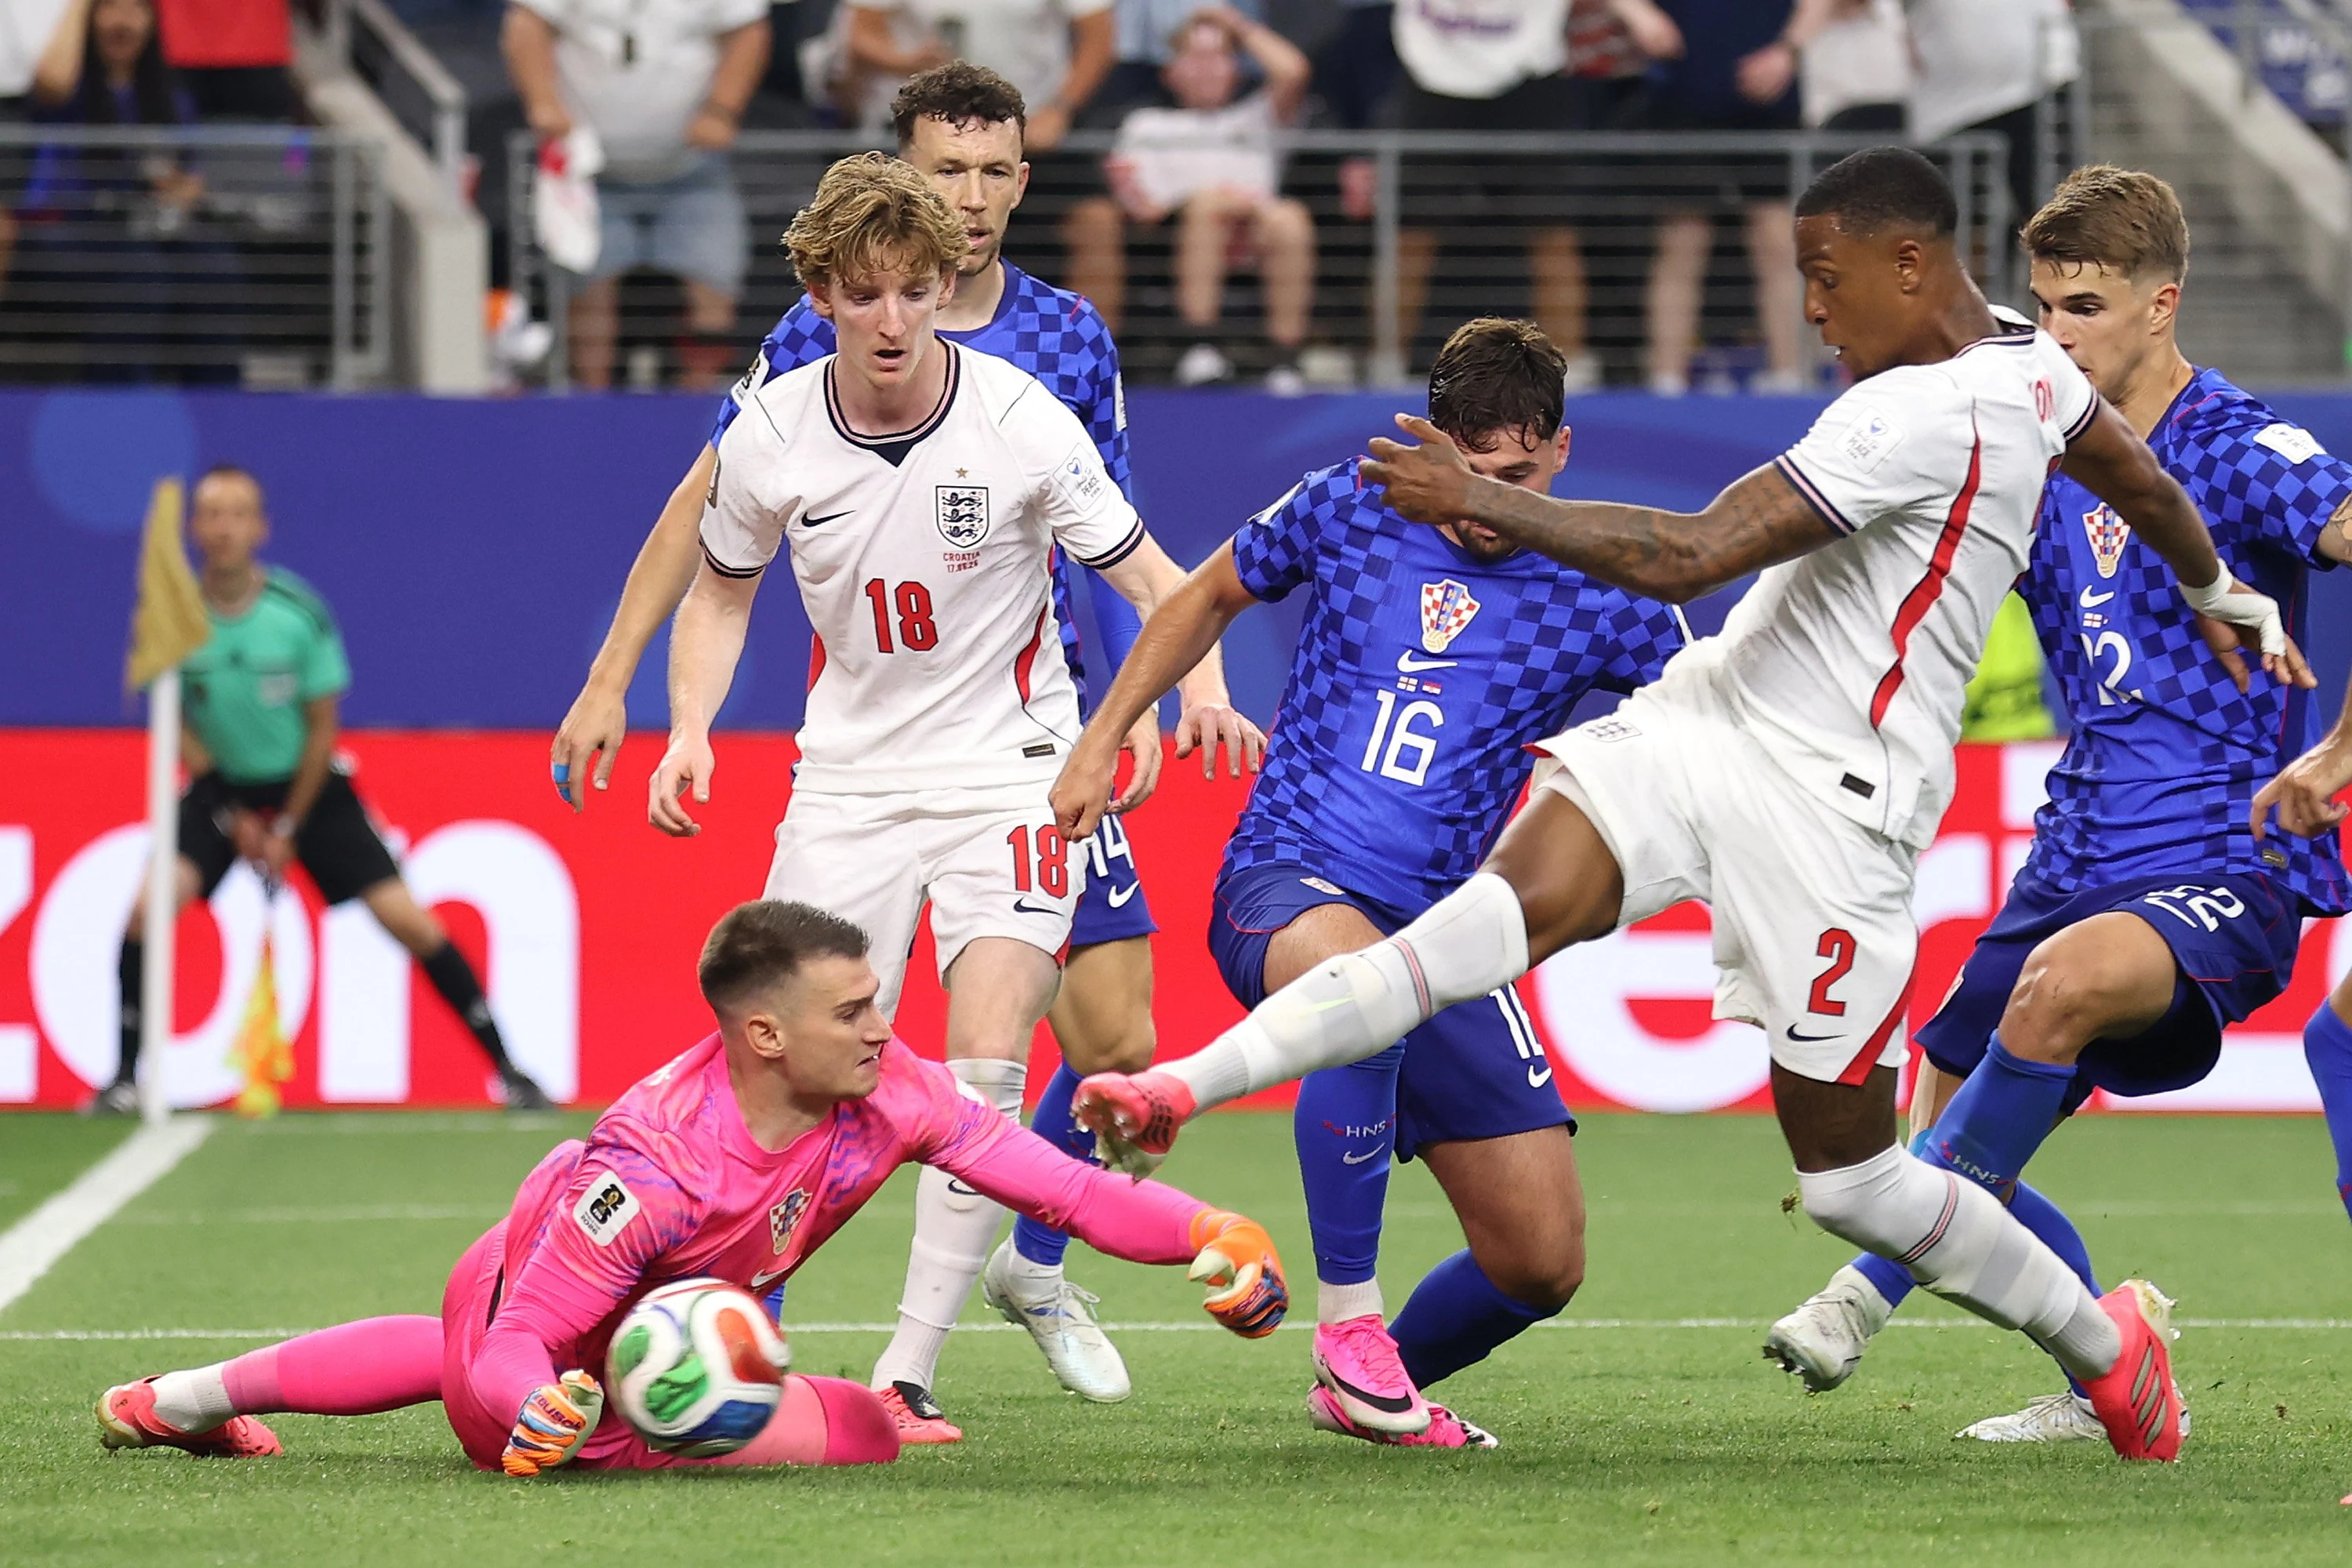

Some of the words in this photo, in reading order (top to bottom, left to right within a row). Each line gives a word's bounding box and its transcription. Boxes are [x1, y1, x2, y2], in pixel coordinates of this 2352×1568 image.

[942, 550, 981, 561] CROATIA
[865, 578, 939, 654] 18
[1360, 688, 1445, 787] 16
[1007, 823, 1069, 900] 18
[1086, 814, 1135, 878] 14
[0, 820, 583, 1107] on
[1806, 927, 1857, 1017] 2
[1345, 1120, 1387, 1138] HNS
[1952, 1153, 2001, 1185] HNS
